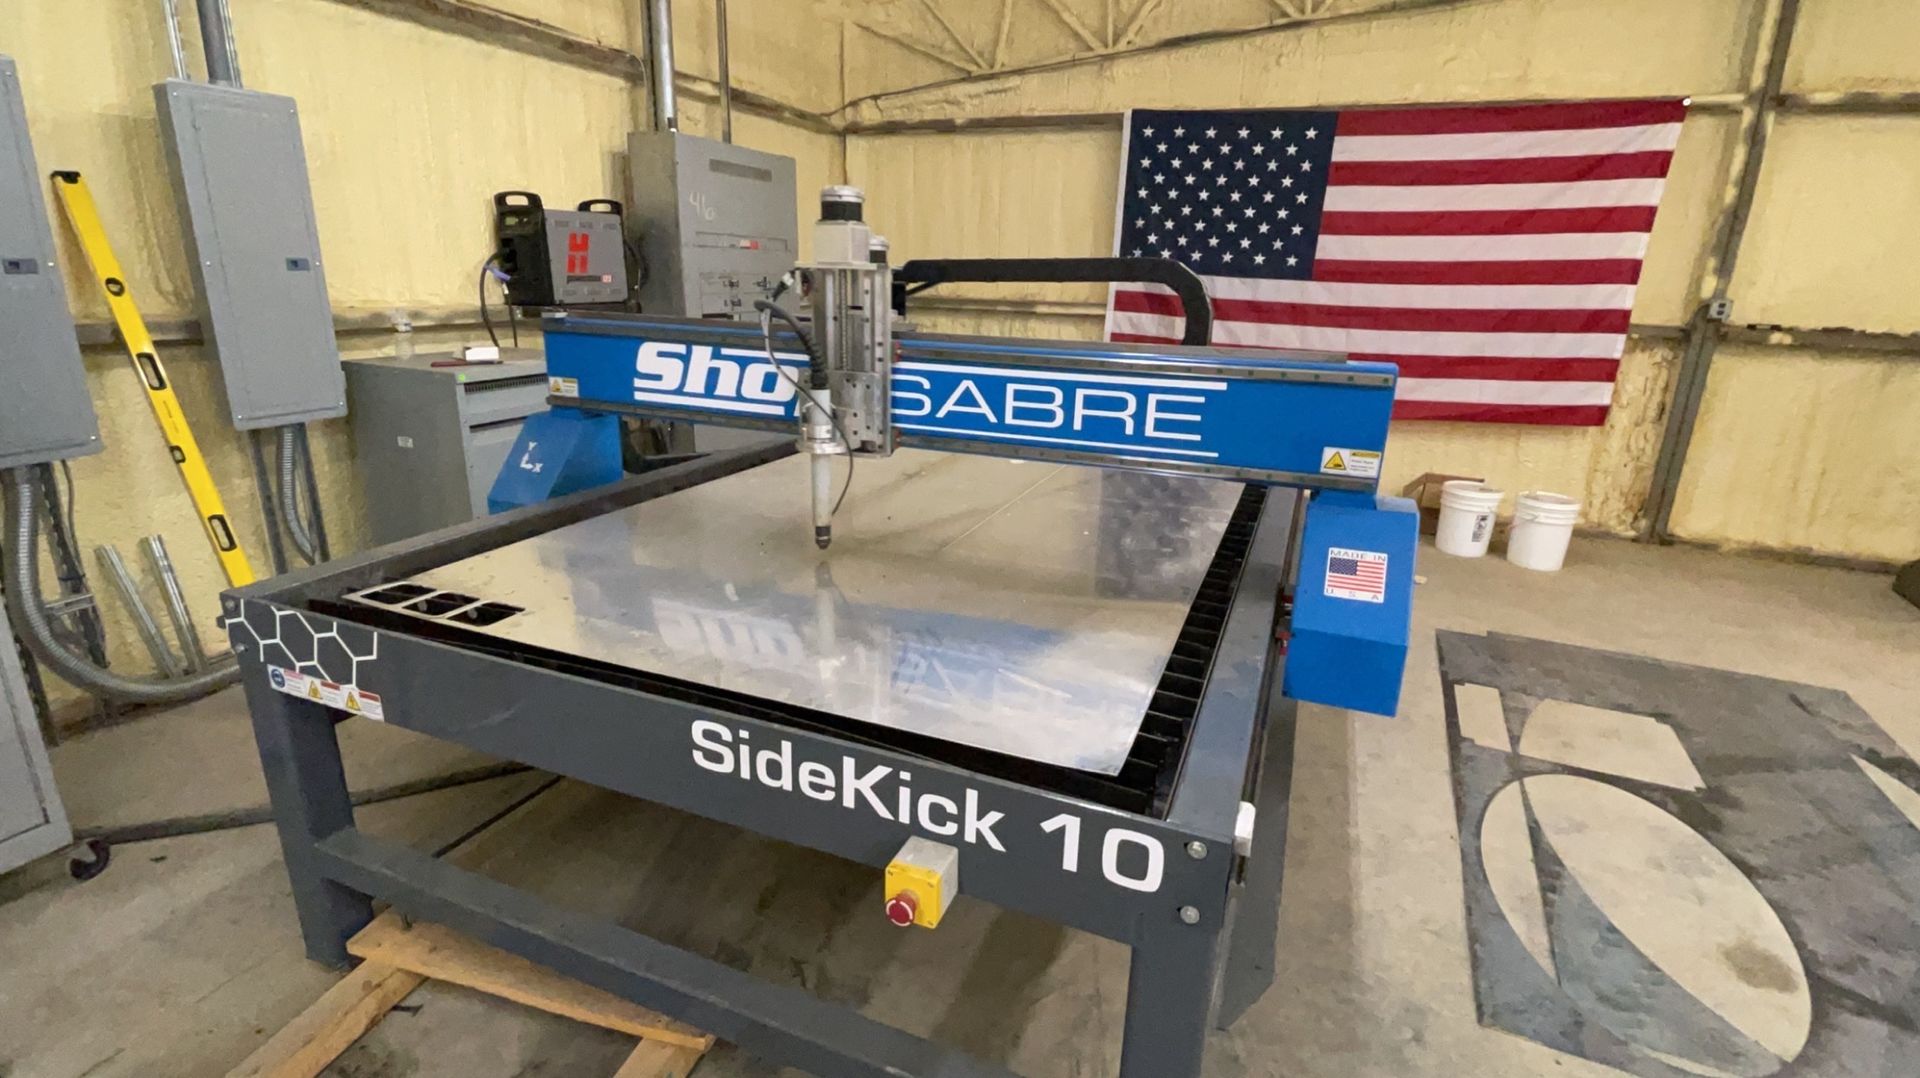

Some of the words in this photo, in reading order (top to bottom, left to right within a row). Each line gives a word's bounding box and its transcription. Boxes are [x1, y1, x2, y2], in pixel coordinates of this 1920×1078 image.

[634, 341, 800, 416] Sho
[891, 374, 1205, 441] SABRE
[1330, 549, 1366, 560] MADE
[1373, 553, 1386, 562] IN
[691, 719, 1006, 853] SideKick
[1040, 813, 1165, 893] 10
